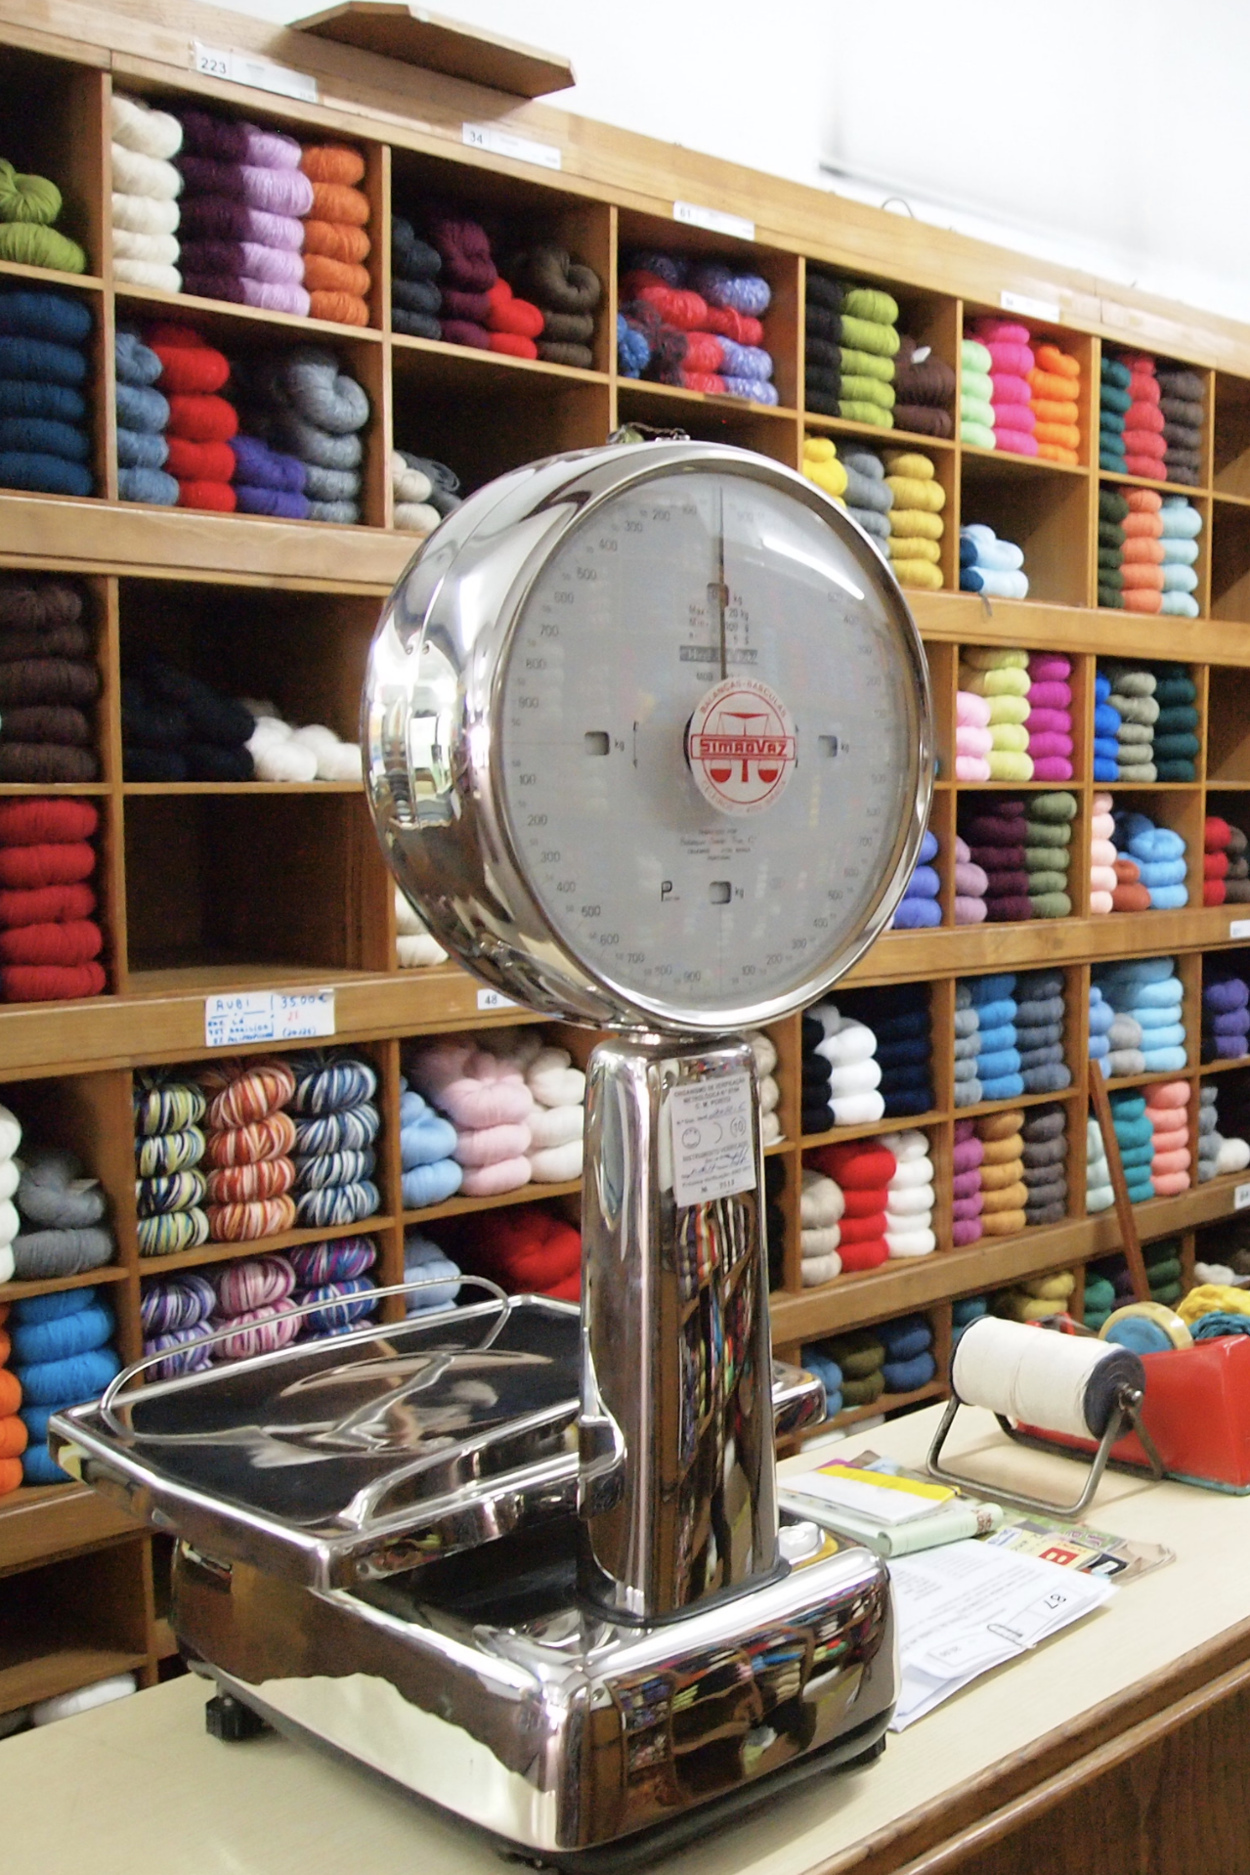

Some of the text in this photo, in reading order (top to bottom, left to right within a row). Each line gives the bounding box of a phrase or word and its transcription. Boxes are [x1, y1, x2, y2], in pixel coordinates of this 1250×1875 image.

[201, 57, 226, 75] 223
[653, 509, 671, 522] 200
[624, 521, 643, 533] 300
[599, 539, 618, 552] 400
[576, 568, 597, 581] 500
[540, 624, 559, 637] 700
[614, 738, 625, 752] kg
[519, 774, 537, 786] 100
[528, 813, 548, 826] 200
[540, 851, 561, 863] 300
[556, 881, 576, 893] 400
[734, 886, 744, 900] kg
[813, 917, 829, 928] 400
[600, 933, 620, 946] 600
[627, 952, 645, 965] 700
[766, 953, 783, 966] 200
[683, 970, 702, 983] 900
[742, 965, 756, 976] 100
[484, 994, 498, 1005] 48
